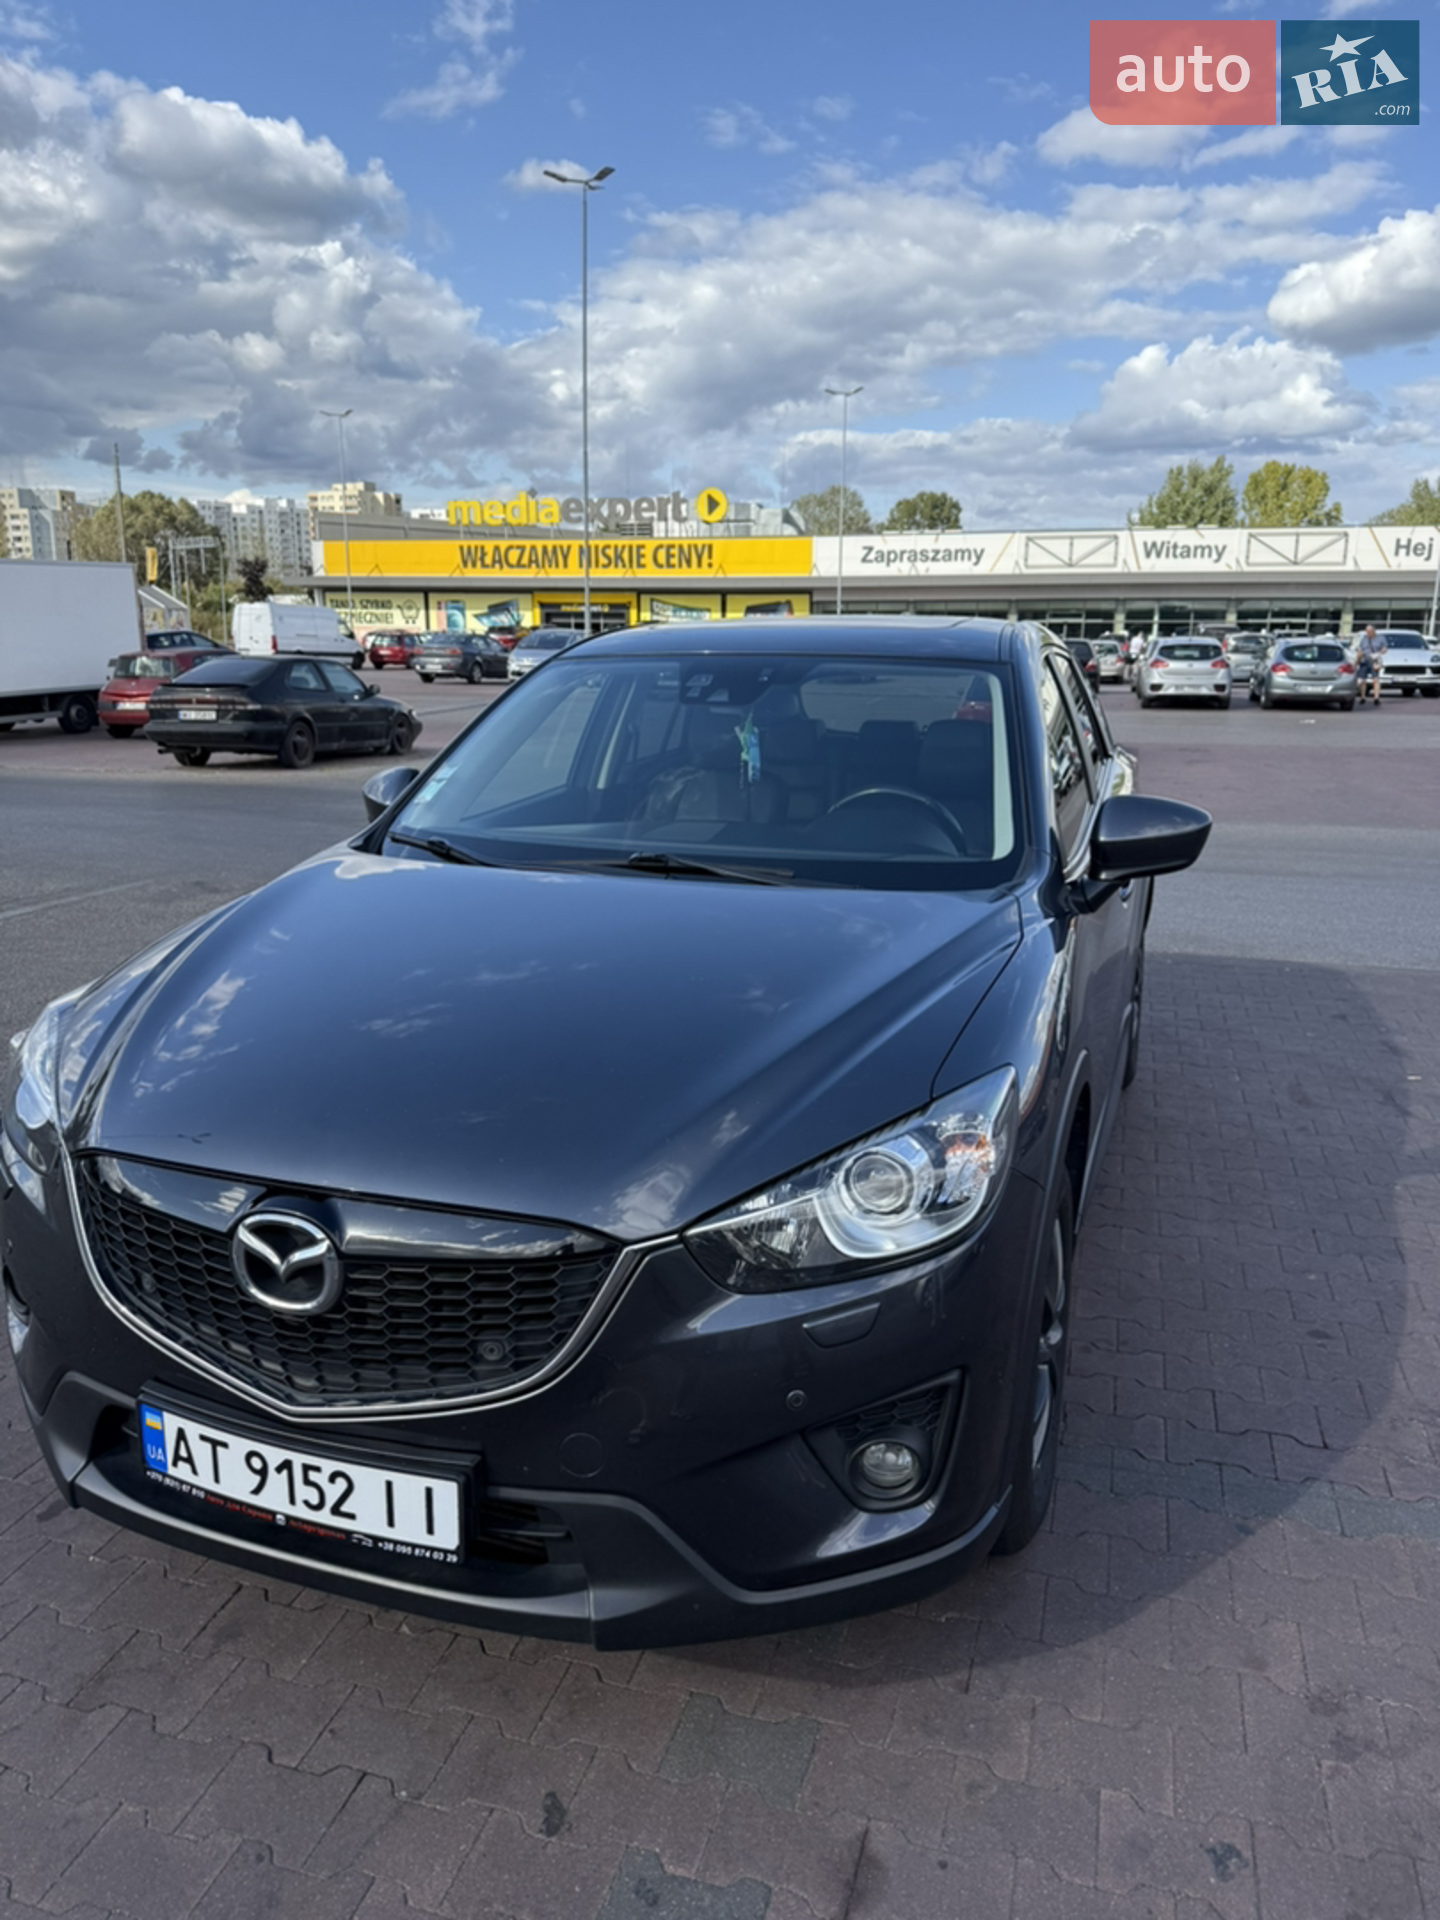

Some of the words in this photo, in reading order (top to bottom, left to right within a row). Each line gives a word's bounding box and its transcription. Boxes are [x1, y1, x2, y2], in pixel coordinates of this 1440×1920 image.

[447, 488, 689, 531] mediaexpert
[459, 544, 572, 571] WŁĄCZAMY
[579, 544, 646, 570] NISKIE
[652, 543, 714, 570] CENY!
[860, 545, 986, 567] Zapraszamy
[1142, 539, 1227, 563] Witamy
[1394, 537, 1434, 562] Hej
[146, 1443, 166, 1463] UA
[171, 1427, 229, 1485] AT
[244, 1449, 357, 1521] 9152
